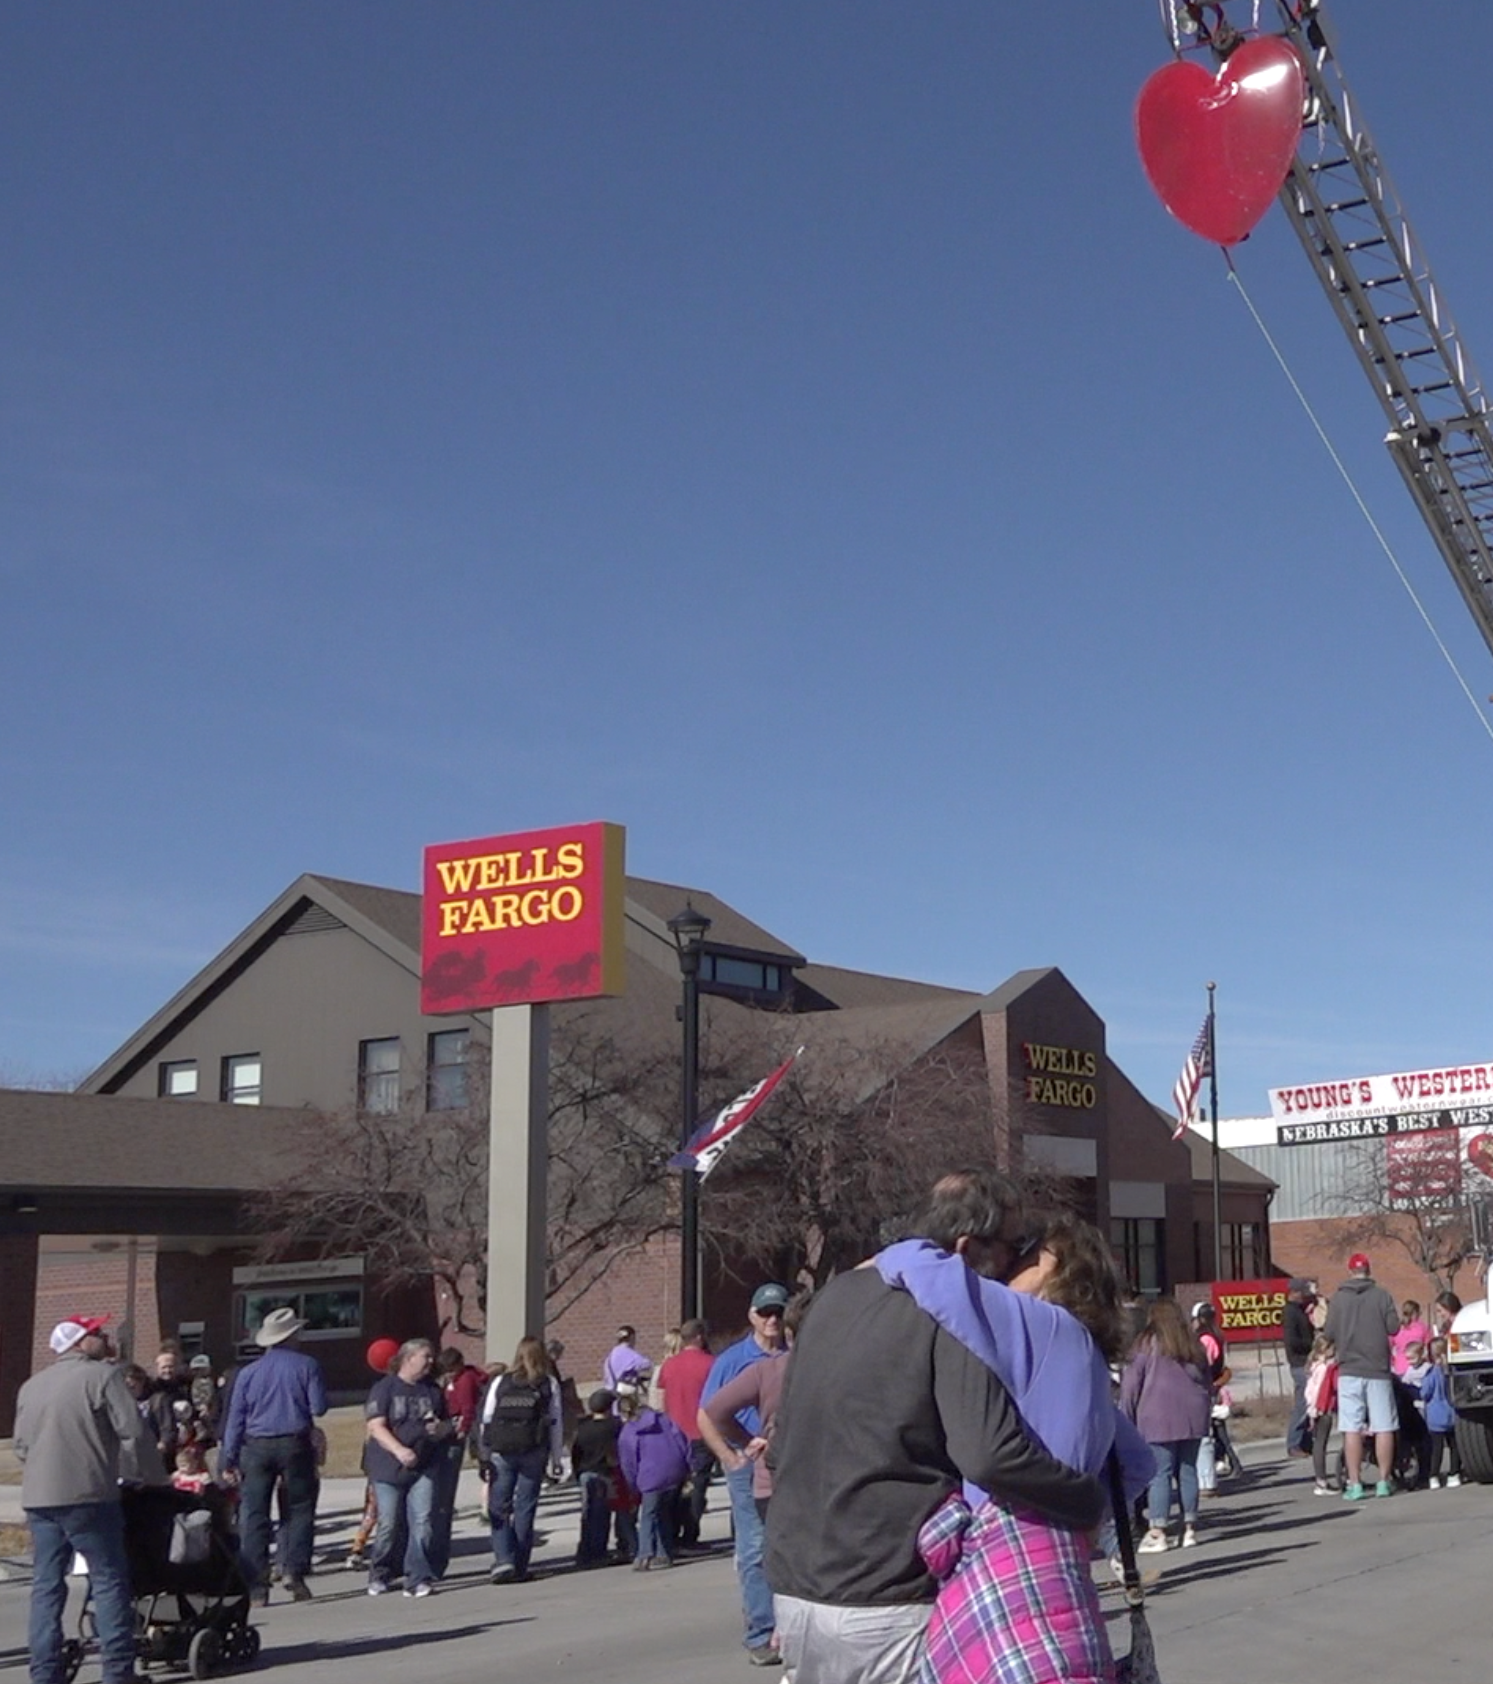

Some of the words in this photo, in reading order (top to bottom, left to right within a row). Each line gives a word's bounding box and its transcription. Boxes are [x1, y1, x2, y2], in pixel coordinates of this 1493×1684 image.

[436, 842, 584, 895] WELLS
[439, 885, 583, 937] FARGO
[1022, 1042, 1096, 1078] WELLS
[1025, 1075, 1096, 1109] FARGO
[1277, 1080, 1373, 1113] YOUNG'S
[1282, 1117, 1389, 1142] NEBRASKA'S
[1396, 1111, 1441, 1132] BEST
[1218, 1292, 1286, 1311] WELLS
